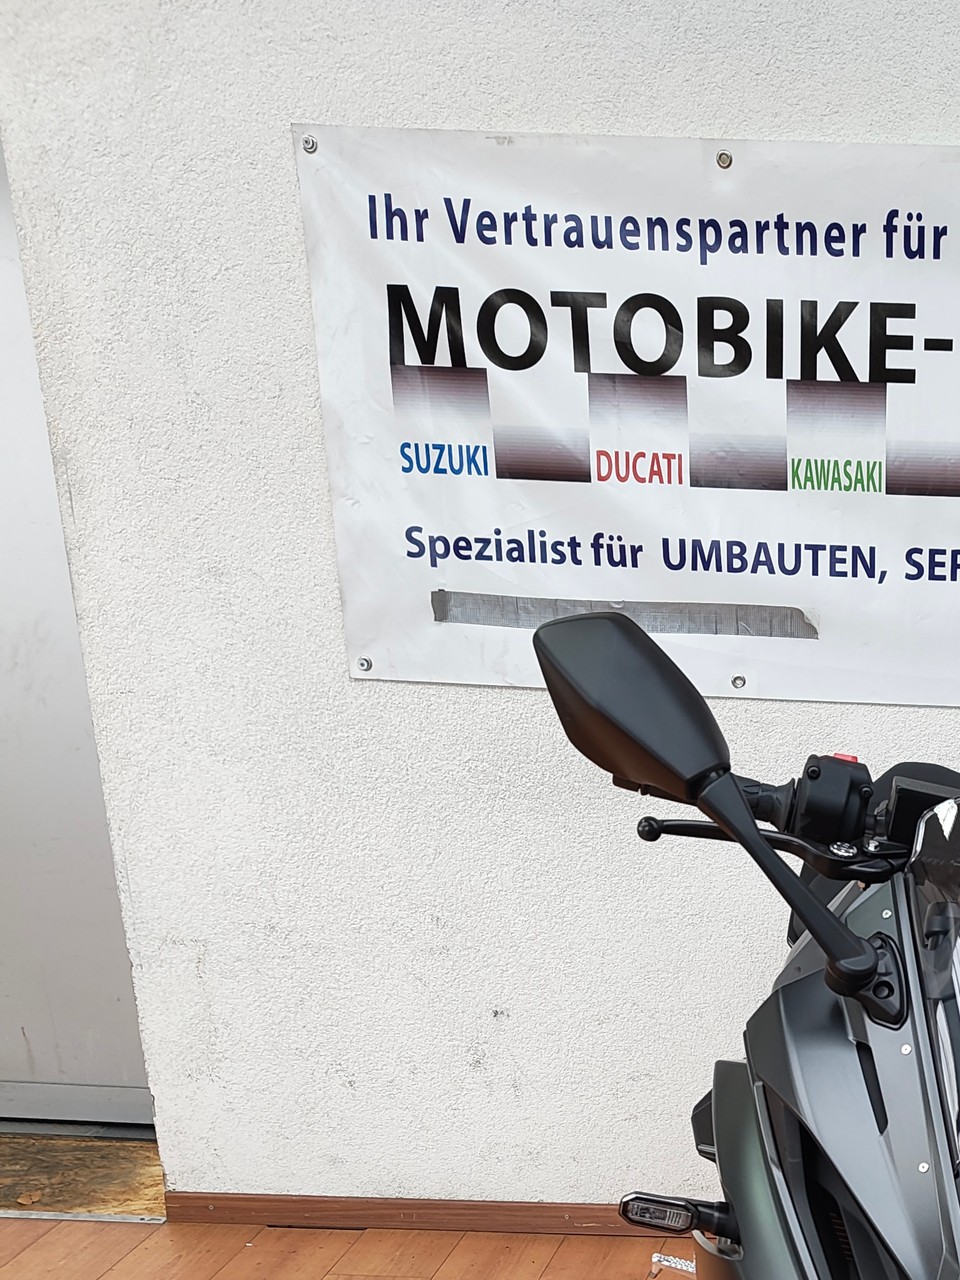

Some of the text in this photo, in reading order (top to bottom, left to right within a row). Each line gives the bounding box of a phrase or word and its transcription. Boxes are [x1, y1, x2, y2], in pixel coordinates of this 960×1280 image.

[368, 194, 429, 243] Ihr
[443, 197, 868, 266] Vertrauenspartner
[882, 208, 948, 260] für
[399, 441, 489, 477] SUZUKI
[596, 450, 684, 486] DUCATI
[790, 457, 884, 494] KAWASAKI
[405, 525, 583, 569] Spezialist
[590, 532, 644, 569] für
[661, 537, 888, 585] UMBAUTEN,
